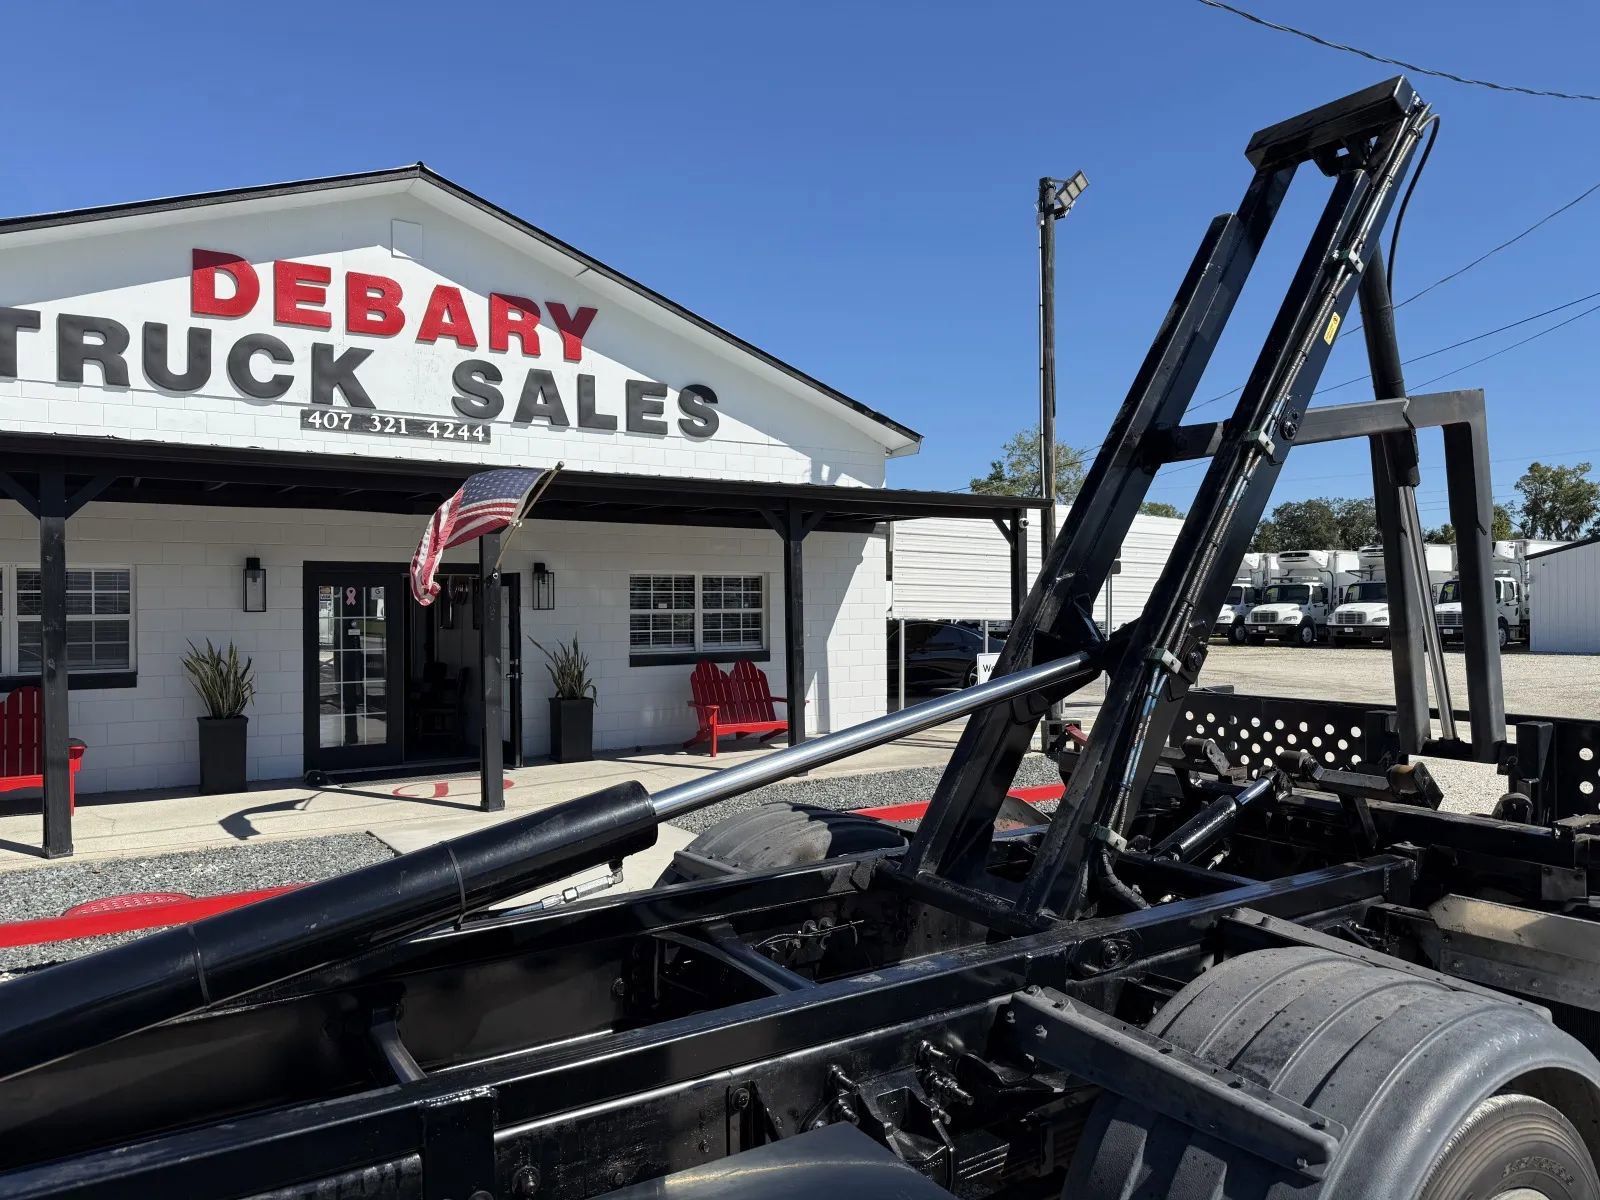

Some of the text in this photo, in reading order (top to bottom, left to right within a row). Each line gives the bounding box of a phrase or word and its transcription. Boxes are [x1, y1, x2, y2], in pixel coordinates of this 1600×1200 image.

[191, 248, 598, 361] DEBARY
[0, 307, 719, 439] TRUCK SALES
[308, 411, 484, 442] 407 321 4244
